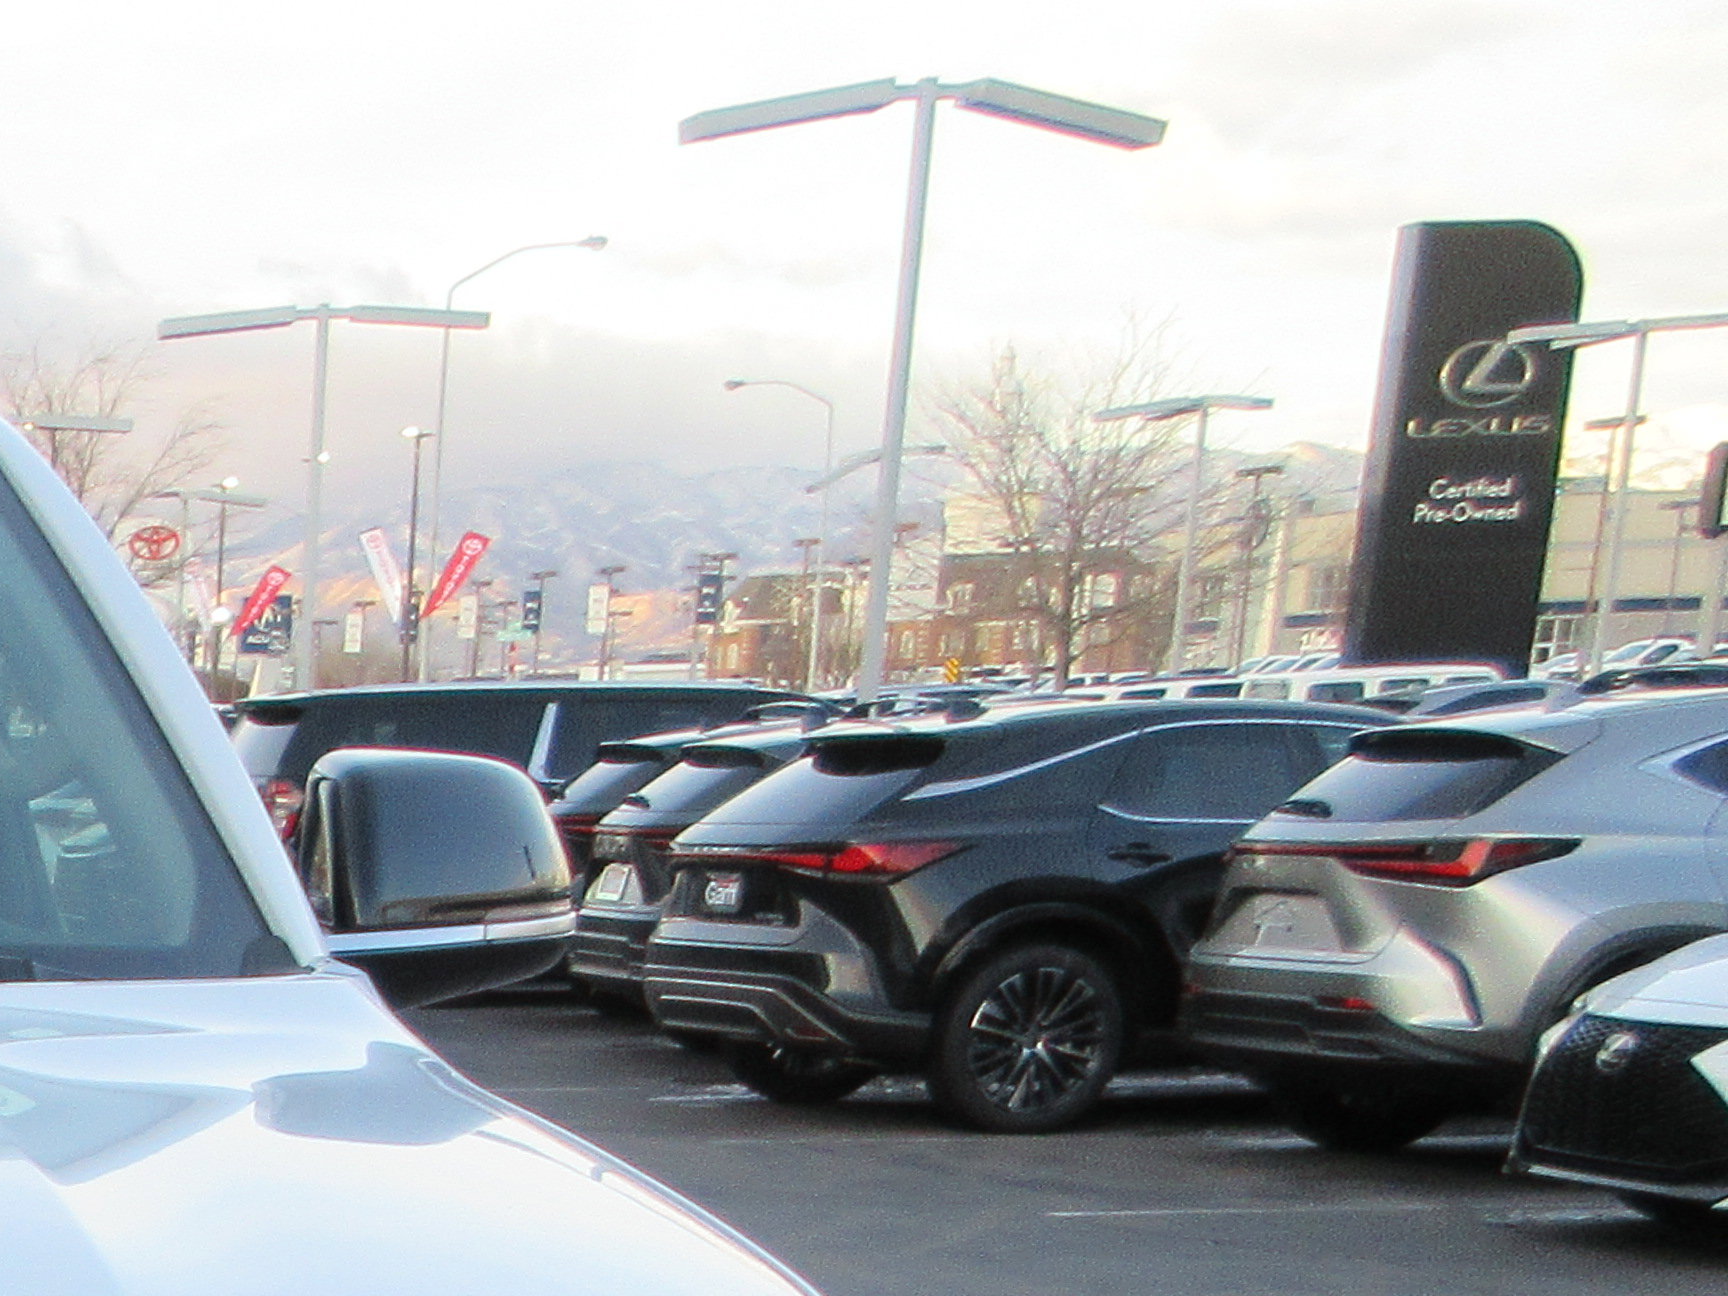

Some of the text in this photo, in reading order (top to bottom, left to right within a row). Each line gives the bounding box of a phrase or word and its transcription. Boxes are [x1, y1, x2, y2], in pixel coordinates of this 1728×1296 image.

[1406, 415, 1552, 438] LEXUS
[1429, 477, 1514, 500] Certified
[1413, 501, 1522, 524] Pre-Owned
